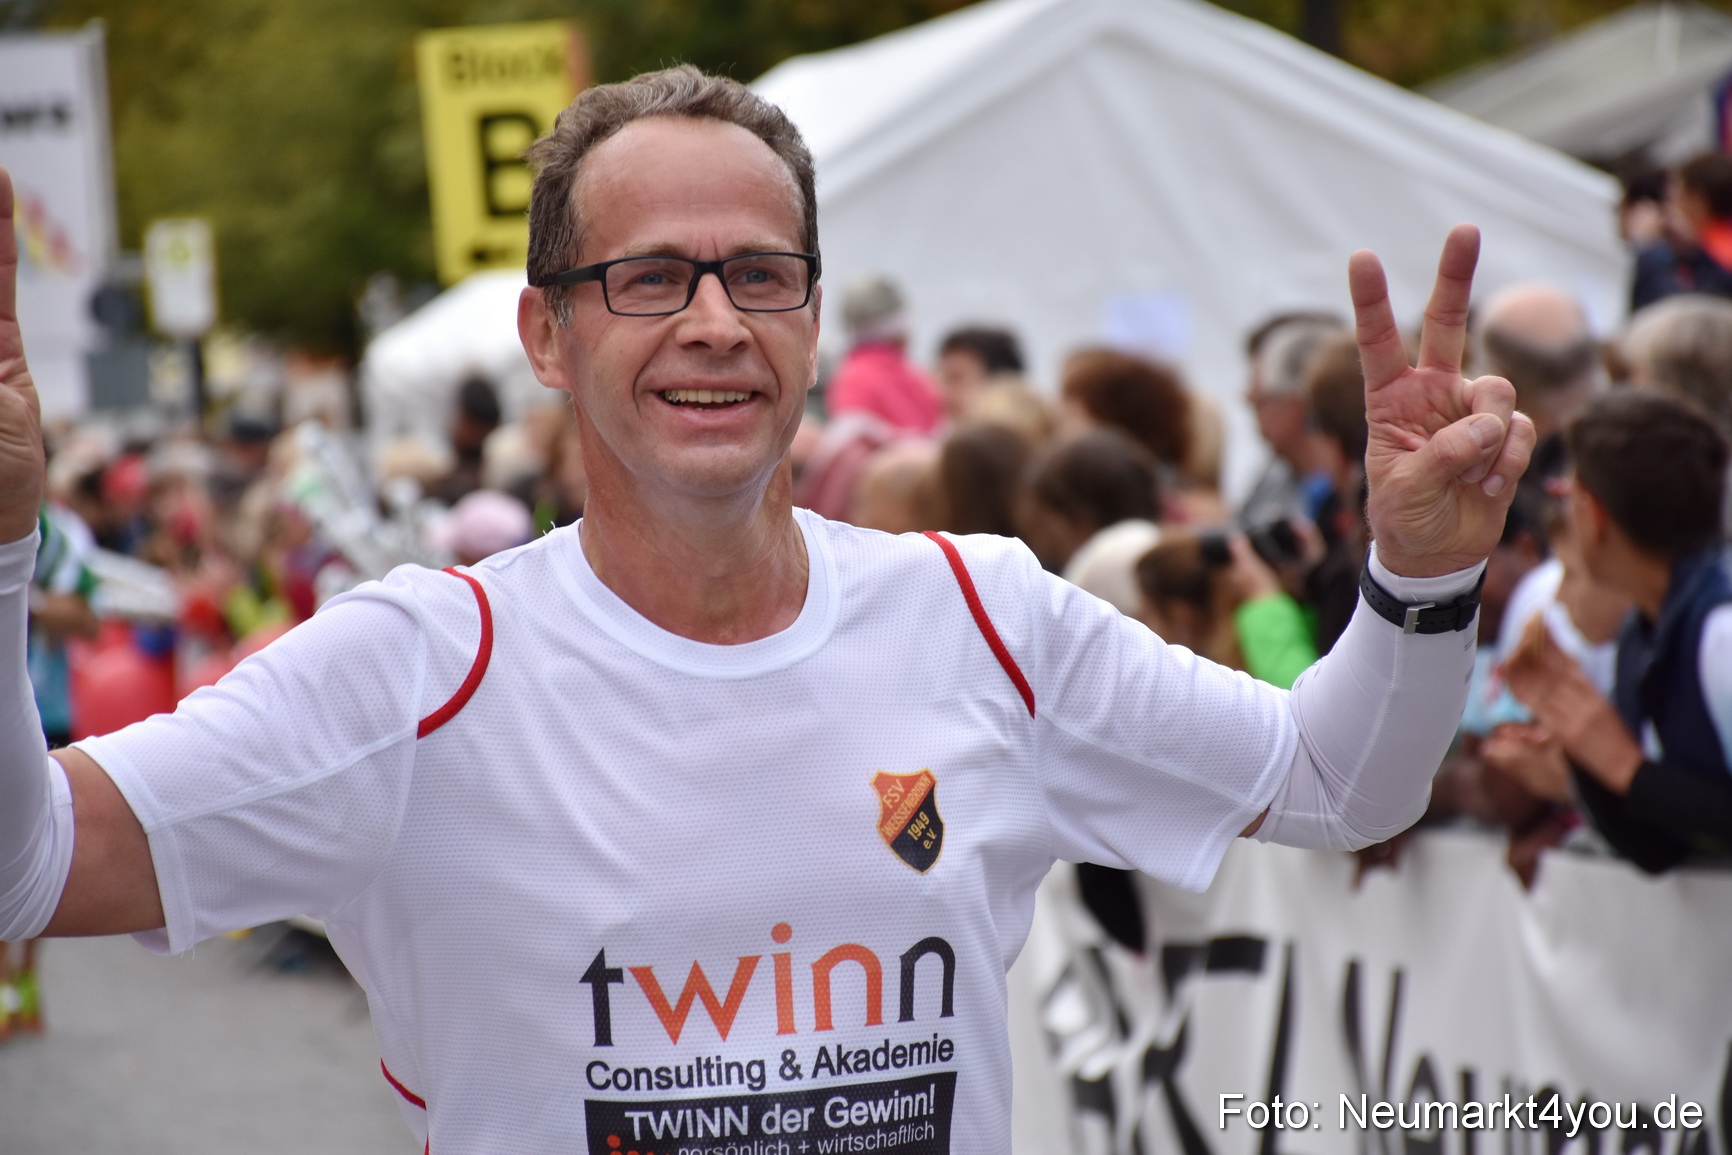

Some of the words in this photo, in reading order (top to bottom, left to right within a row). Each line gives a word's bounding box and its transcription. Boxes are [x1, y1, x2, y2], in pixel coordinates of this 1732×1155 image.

[479, 112, 540, 219] B
[882, 779, 905, 808] FSV
[907, 811, 930, 840] 1949
[579, 922, 956, 1047] twinn
[585, 1055, 766, 1091] Consulting
[779, 1049, 803, 1081] &
[811, 1033, 954, 1079] Akademie
[624, 1105, 749, 1141] TWINN
[761, 1103, 815, 1135] der
[824, 1083, 936, 1128] Gewinn!
[798, 1140, 810, 1154] +
[817, 1121, 935, 1154] wirtschaftlich
